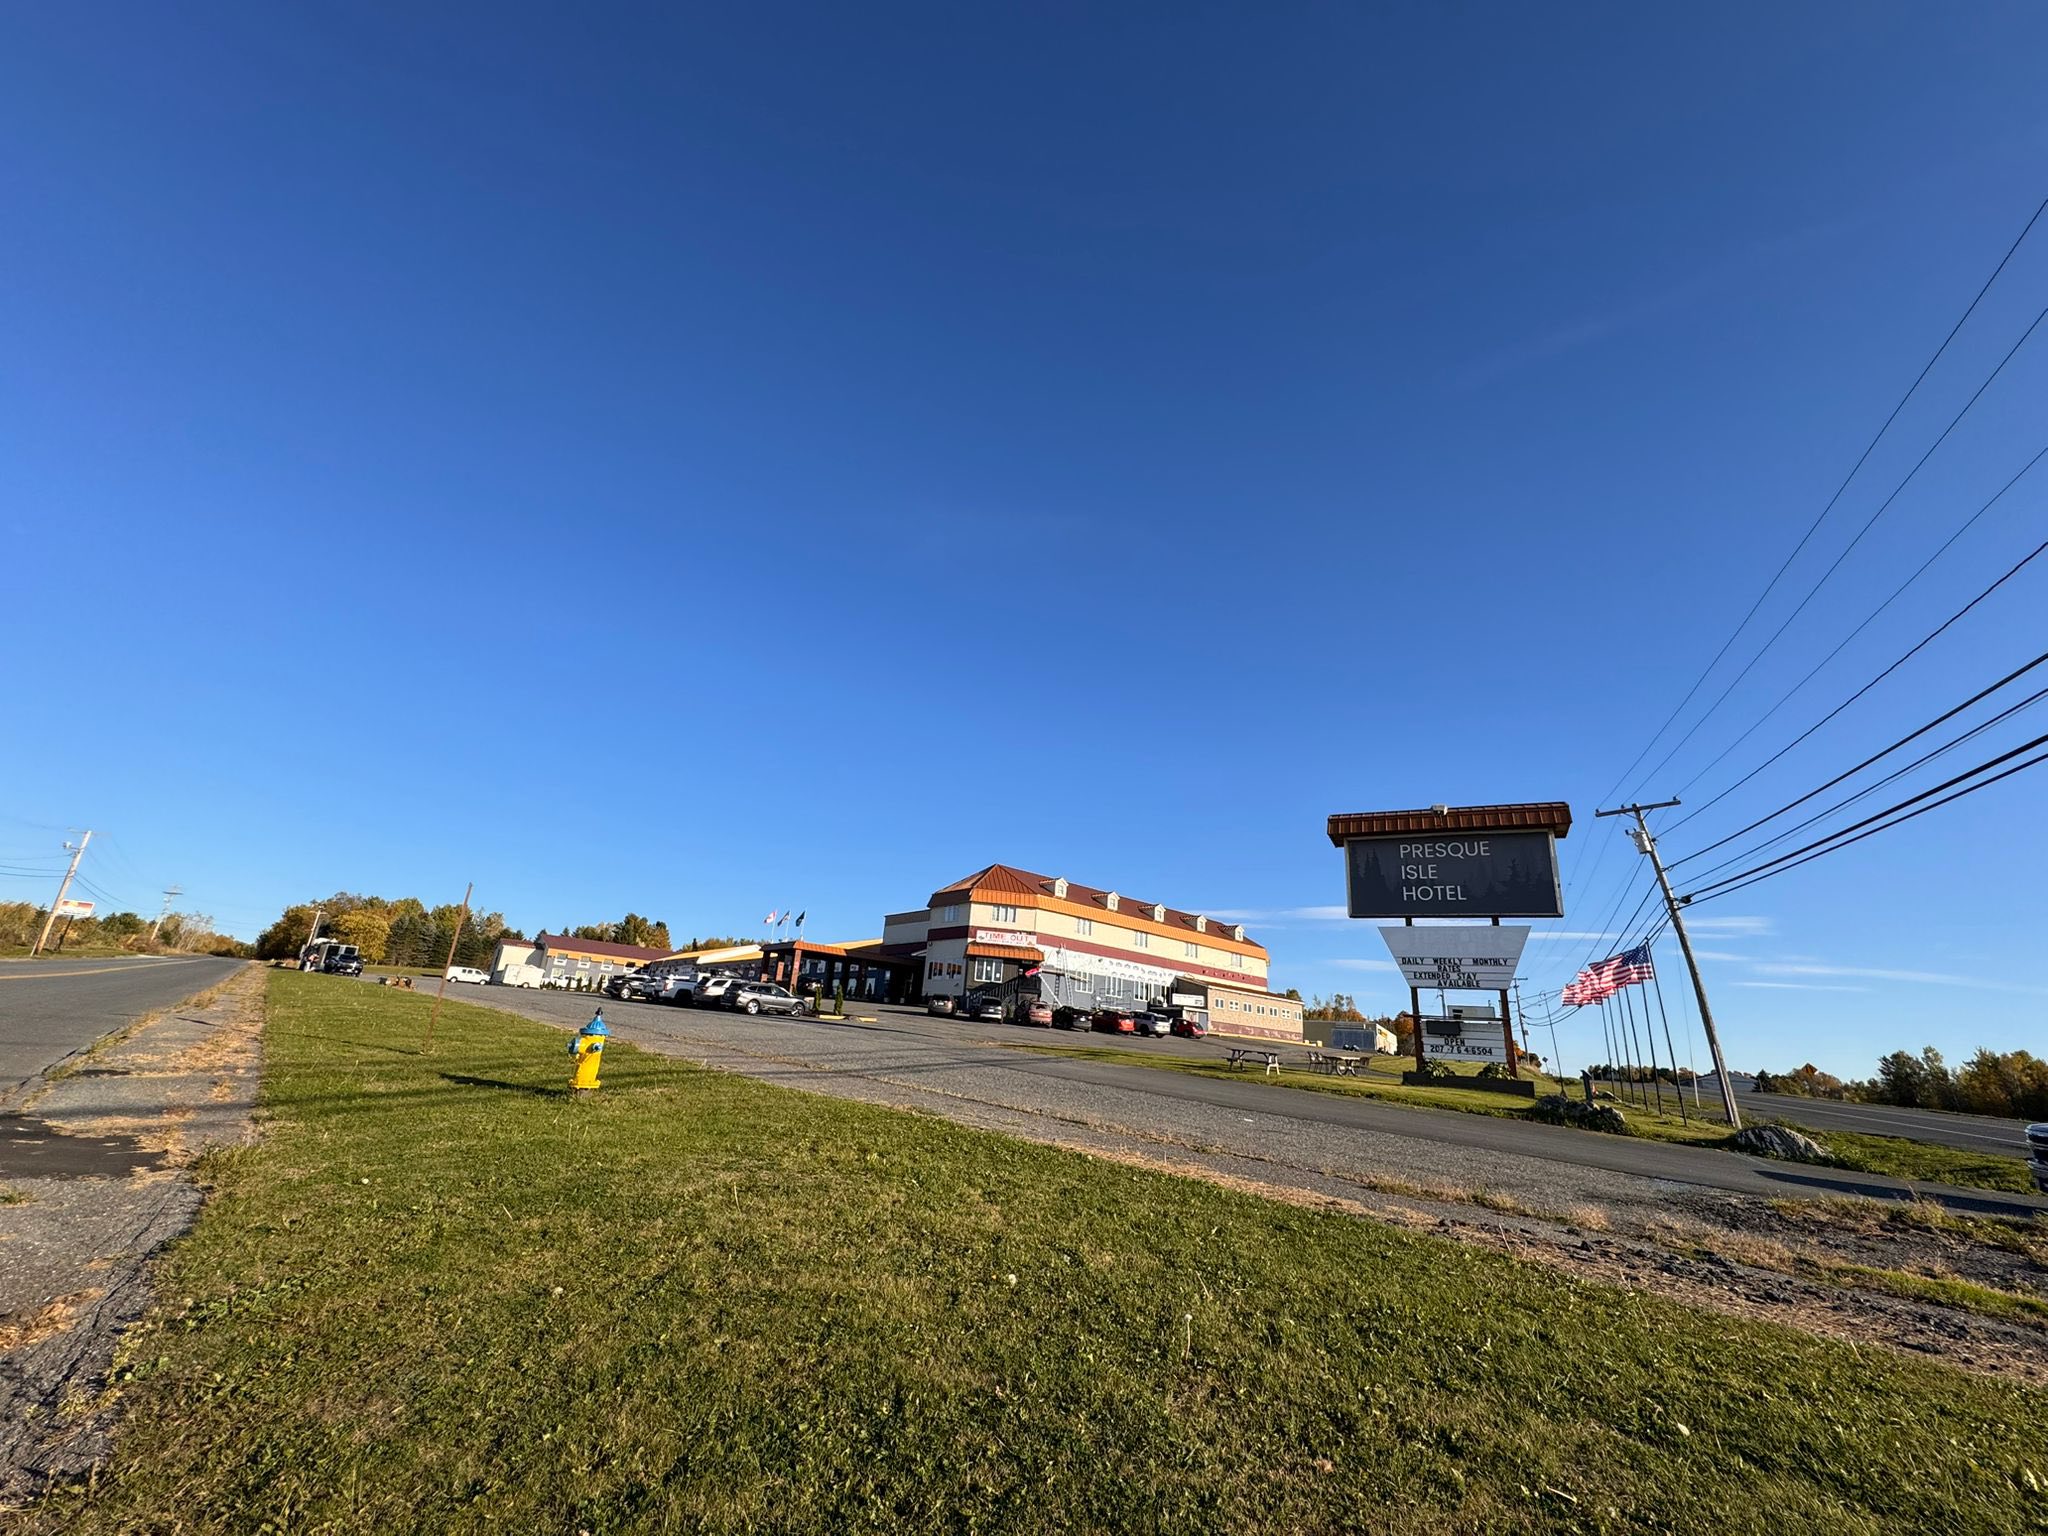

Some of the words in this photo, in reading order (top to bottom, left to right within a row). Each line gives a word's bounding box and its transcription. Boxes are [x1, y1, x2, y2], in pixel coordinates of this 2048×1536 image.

[1399, 841, 1491, 859] PRESQUE
[1400, 864, 1438, 880] ISLE
[1402, 885, 1467, 901] HOTEL
[985, 932, 1004, 940] TIME
[1010, 934, 1029, 942] OUT
[1401, 957, 1425, 965] DAILY
[1432, 957, 1463, 965] WEEKLY
[1472, 958, 1508, 966] MONTHLY
[1437, 965, 1461, 973] RATES
[1413, 972, 1450, 980] EXTENDED
[1437, 980, 1481, 988] AVAILABLE
[1444, 1038, 1466, 1046] OPEN
